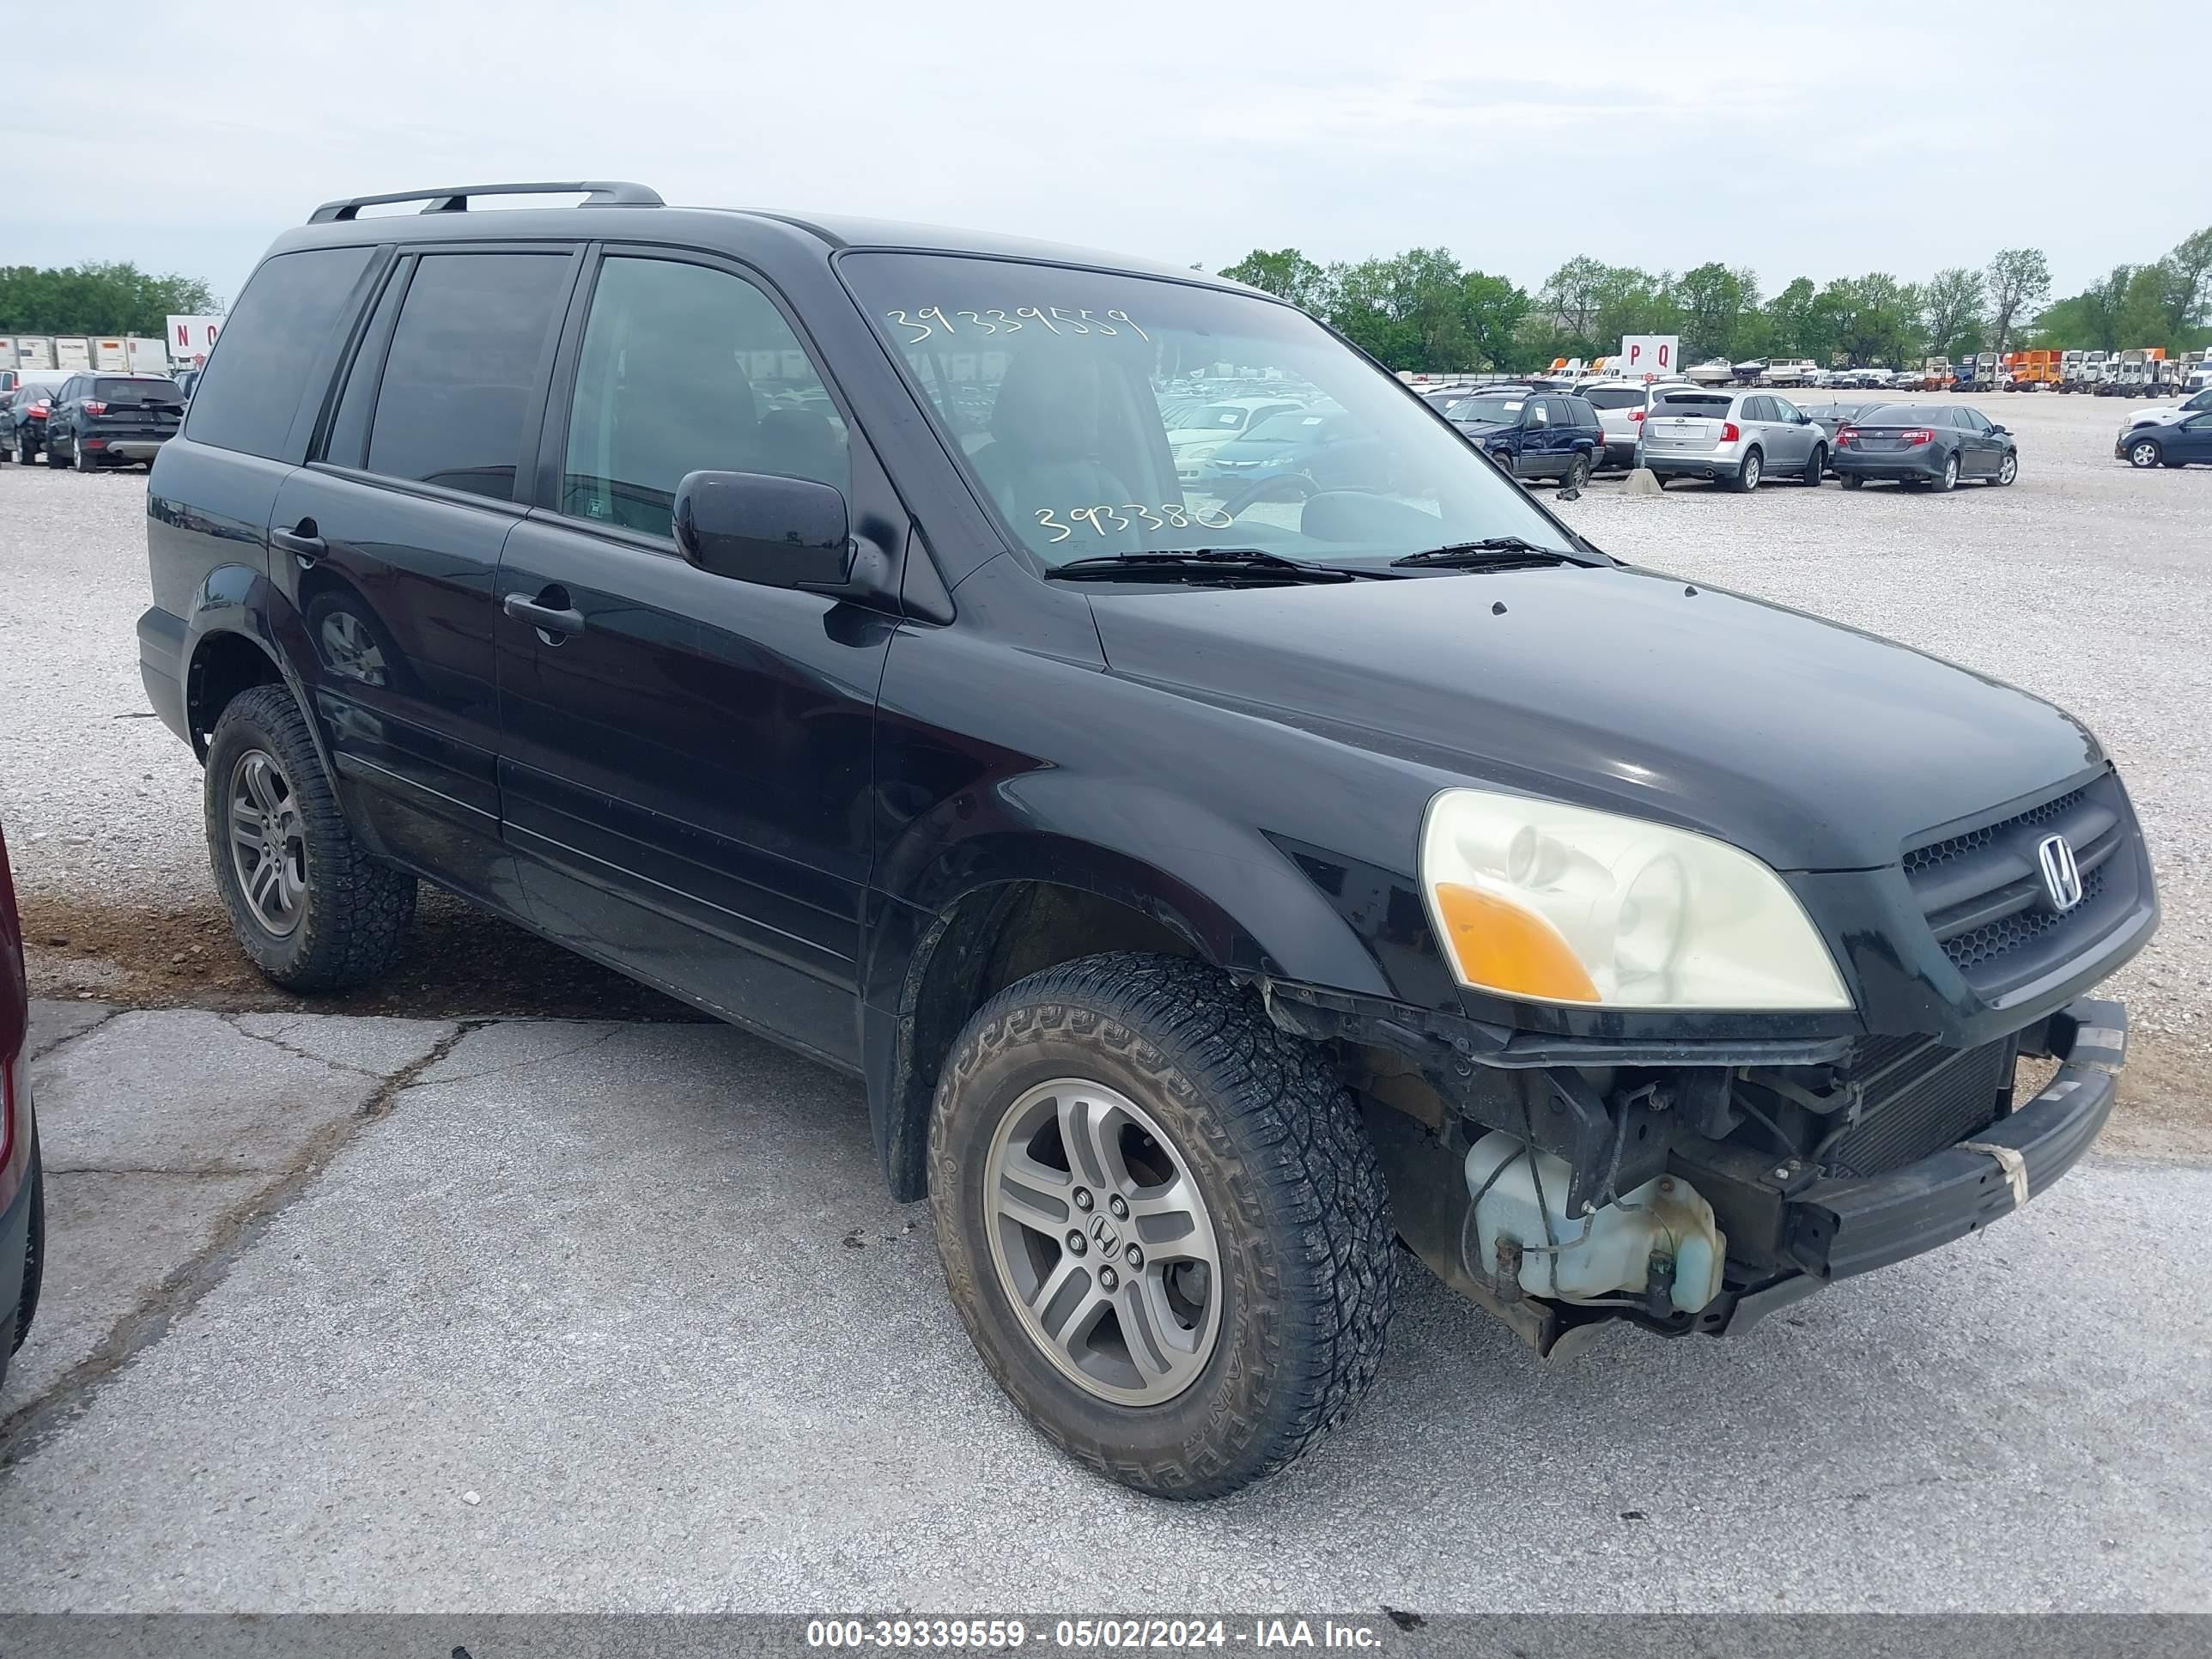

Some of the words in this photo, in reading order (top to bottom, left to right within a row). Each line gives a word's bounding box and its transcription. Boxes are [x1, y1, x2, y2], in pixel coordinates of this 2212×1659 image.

[178, 325, 189, 346] N
[208, 325, 217, 346] O
[886, 306, 1149, 344] 39339559
[1631, 345, 1640, 366] P
[1659, 344, 1668, 368] Q
[1034, 504, 1233, 544] 393380
[1209, 1211, 1249, 1415] TERRAIN
